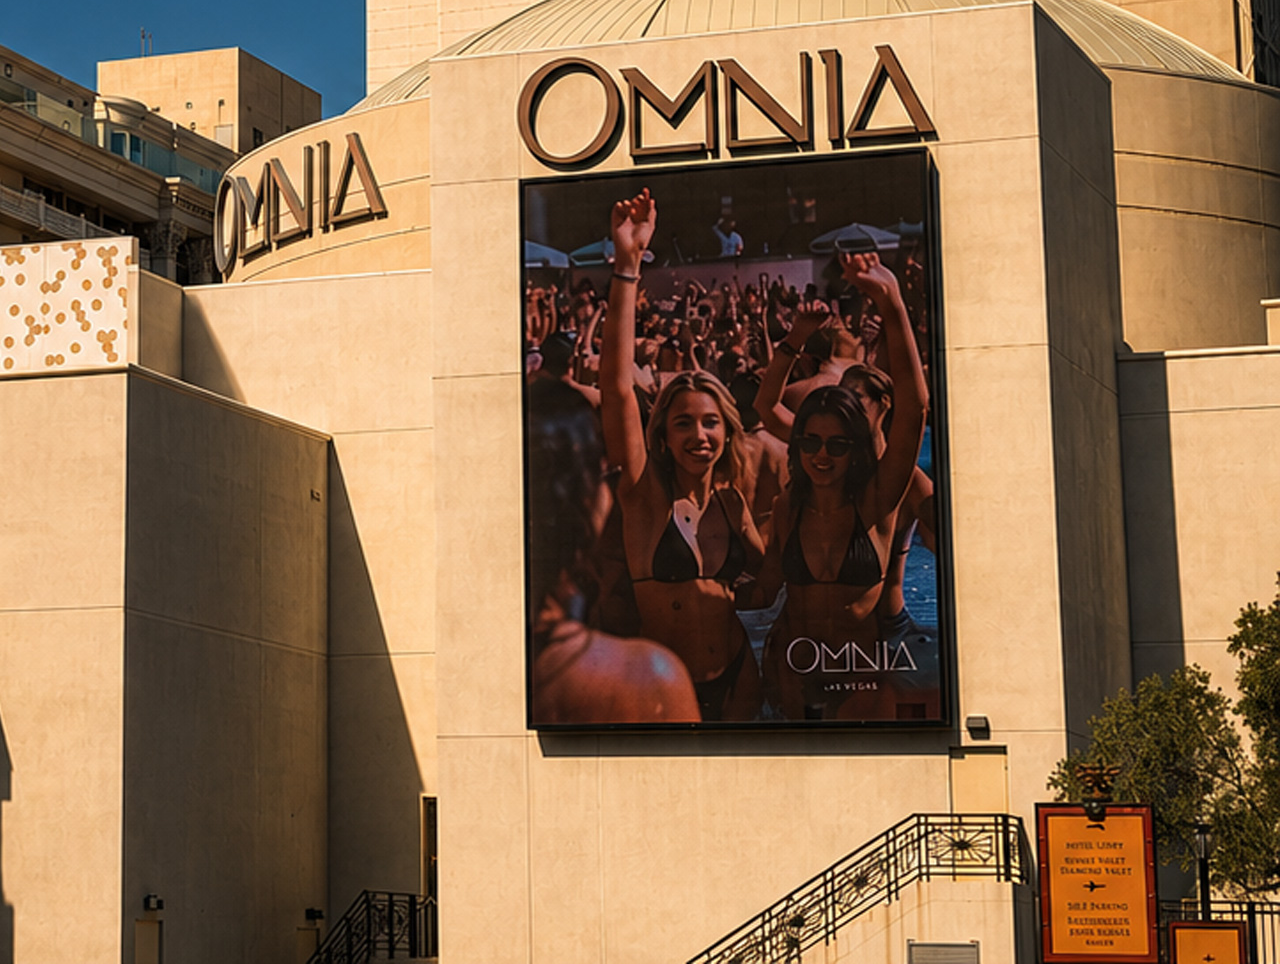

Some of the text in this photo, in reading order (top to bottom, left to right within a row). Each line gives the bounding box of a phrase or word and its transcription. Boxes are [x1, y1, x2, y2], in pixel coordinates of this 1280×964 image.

[517, 44, 940, 172] OMNIA
[214, 132, 388, 282] OMNIA
[786, 637, 917, 673] OMNIA
[844, 682, 878, 690] VEGAS
